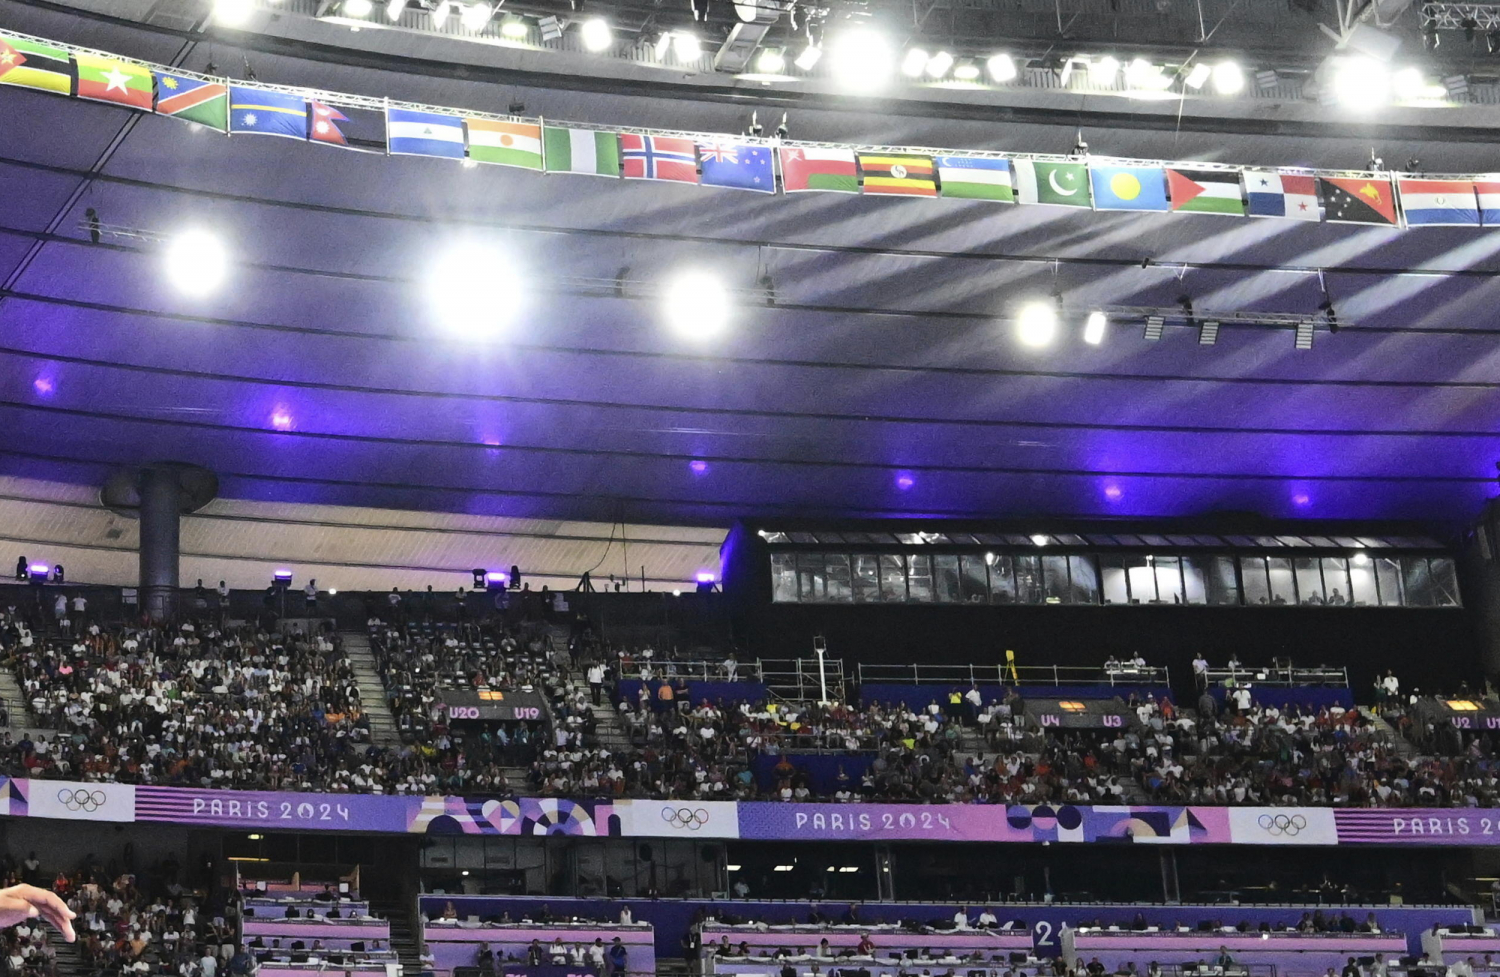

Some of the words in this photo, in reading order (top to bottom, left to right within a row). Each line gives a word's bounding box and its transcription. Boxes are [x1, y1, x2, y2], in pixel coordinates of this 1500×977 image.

[449, 706, 479, 720] U20
[514, 707, 540, 720] U19
[1041, 714, 1060, 727] U4
[1103, 714, 1122, 728] U3
[1451, 716, 1471, 730] U2
[192, 798, 269, 819] PARIS
[280, 801, 349, 822] 2024
[796, 812, 871, 832] PARIS
[882, 813, 949, 832] 2024
[1393, 817, 1470, 835] PARIS
